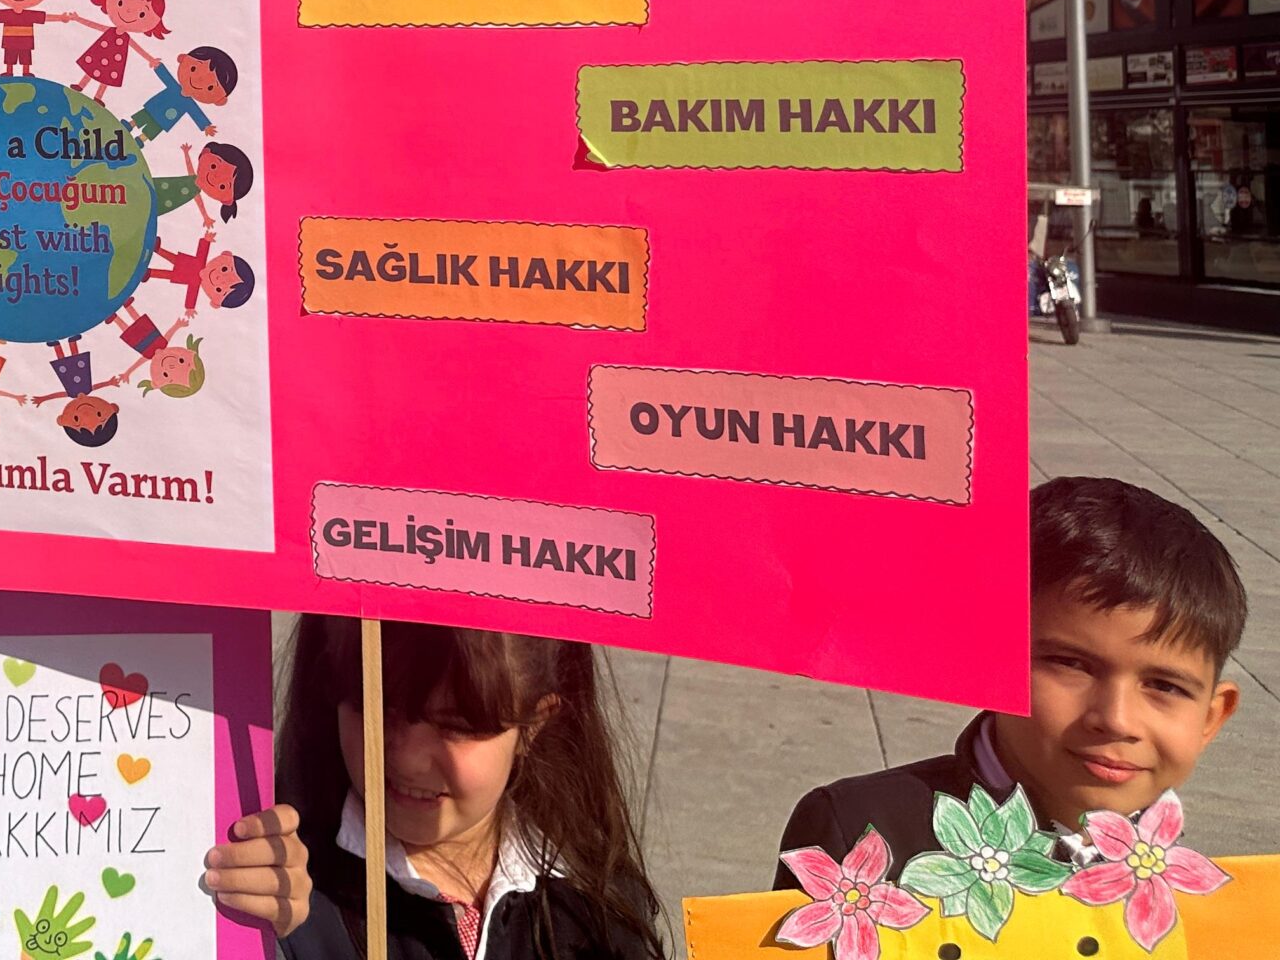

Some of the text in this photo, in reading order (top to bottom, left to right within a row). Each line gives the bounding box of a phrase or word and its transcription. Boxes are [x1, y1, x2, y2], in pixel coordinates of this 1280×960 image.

[609, 98, 937, 134] BAKIM HAKKI
[7, 137, 26, 159] a
[35, 127, 127, 161] Child
[315, 242, 630, 295] SAĞLIK HAKKI
[629, 401, 926, 460] OYUN HAKKI
[80, 461, 215, 504] Varım!
[322, 514, 637, 582] GELİŞİM HAKKI
[6, 691, 193, 743] DESERVES
